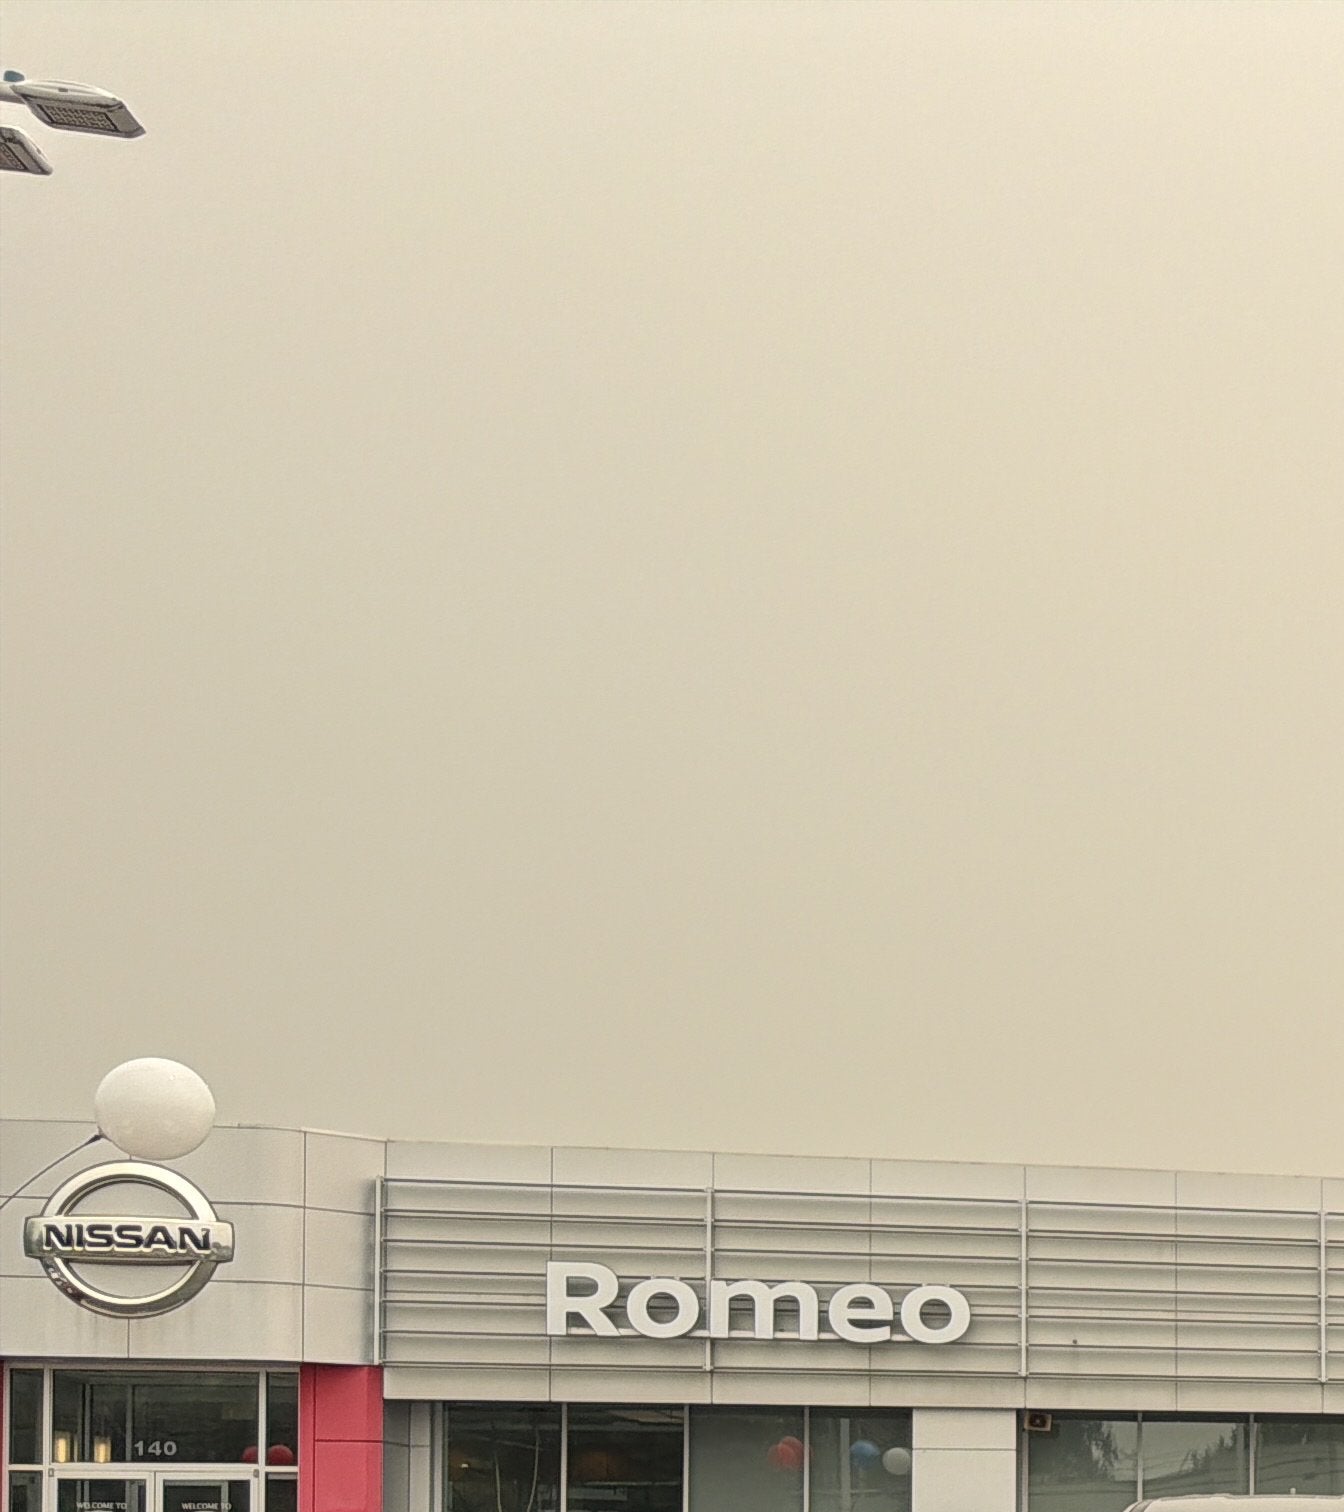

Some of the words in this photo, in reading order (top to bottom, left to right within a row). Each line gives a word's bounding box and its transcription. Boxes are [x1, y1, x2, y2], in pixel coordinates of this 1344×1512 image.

[43, 1223, 211, 1252] NISSAN
[546, 1260, 971, 1343] Romeo
[134, 1440, 177, 1456] 140
